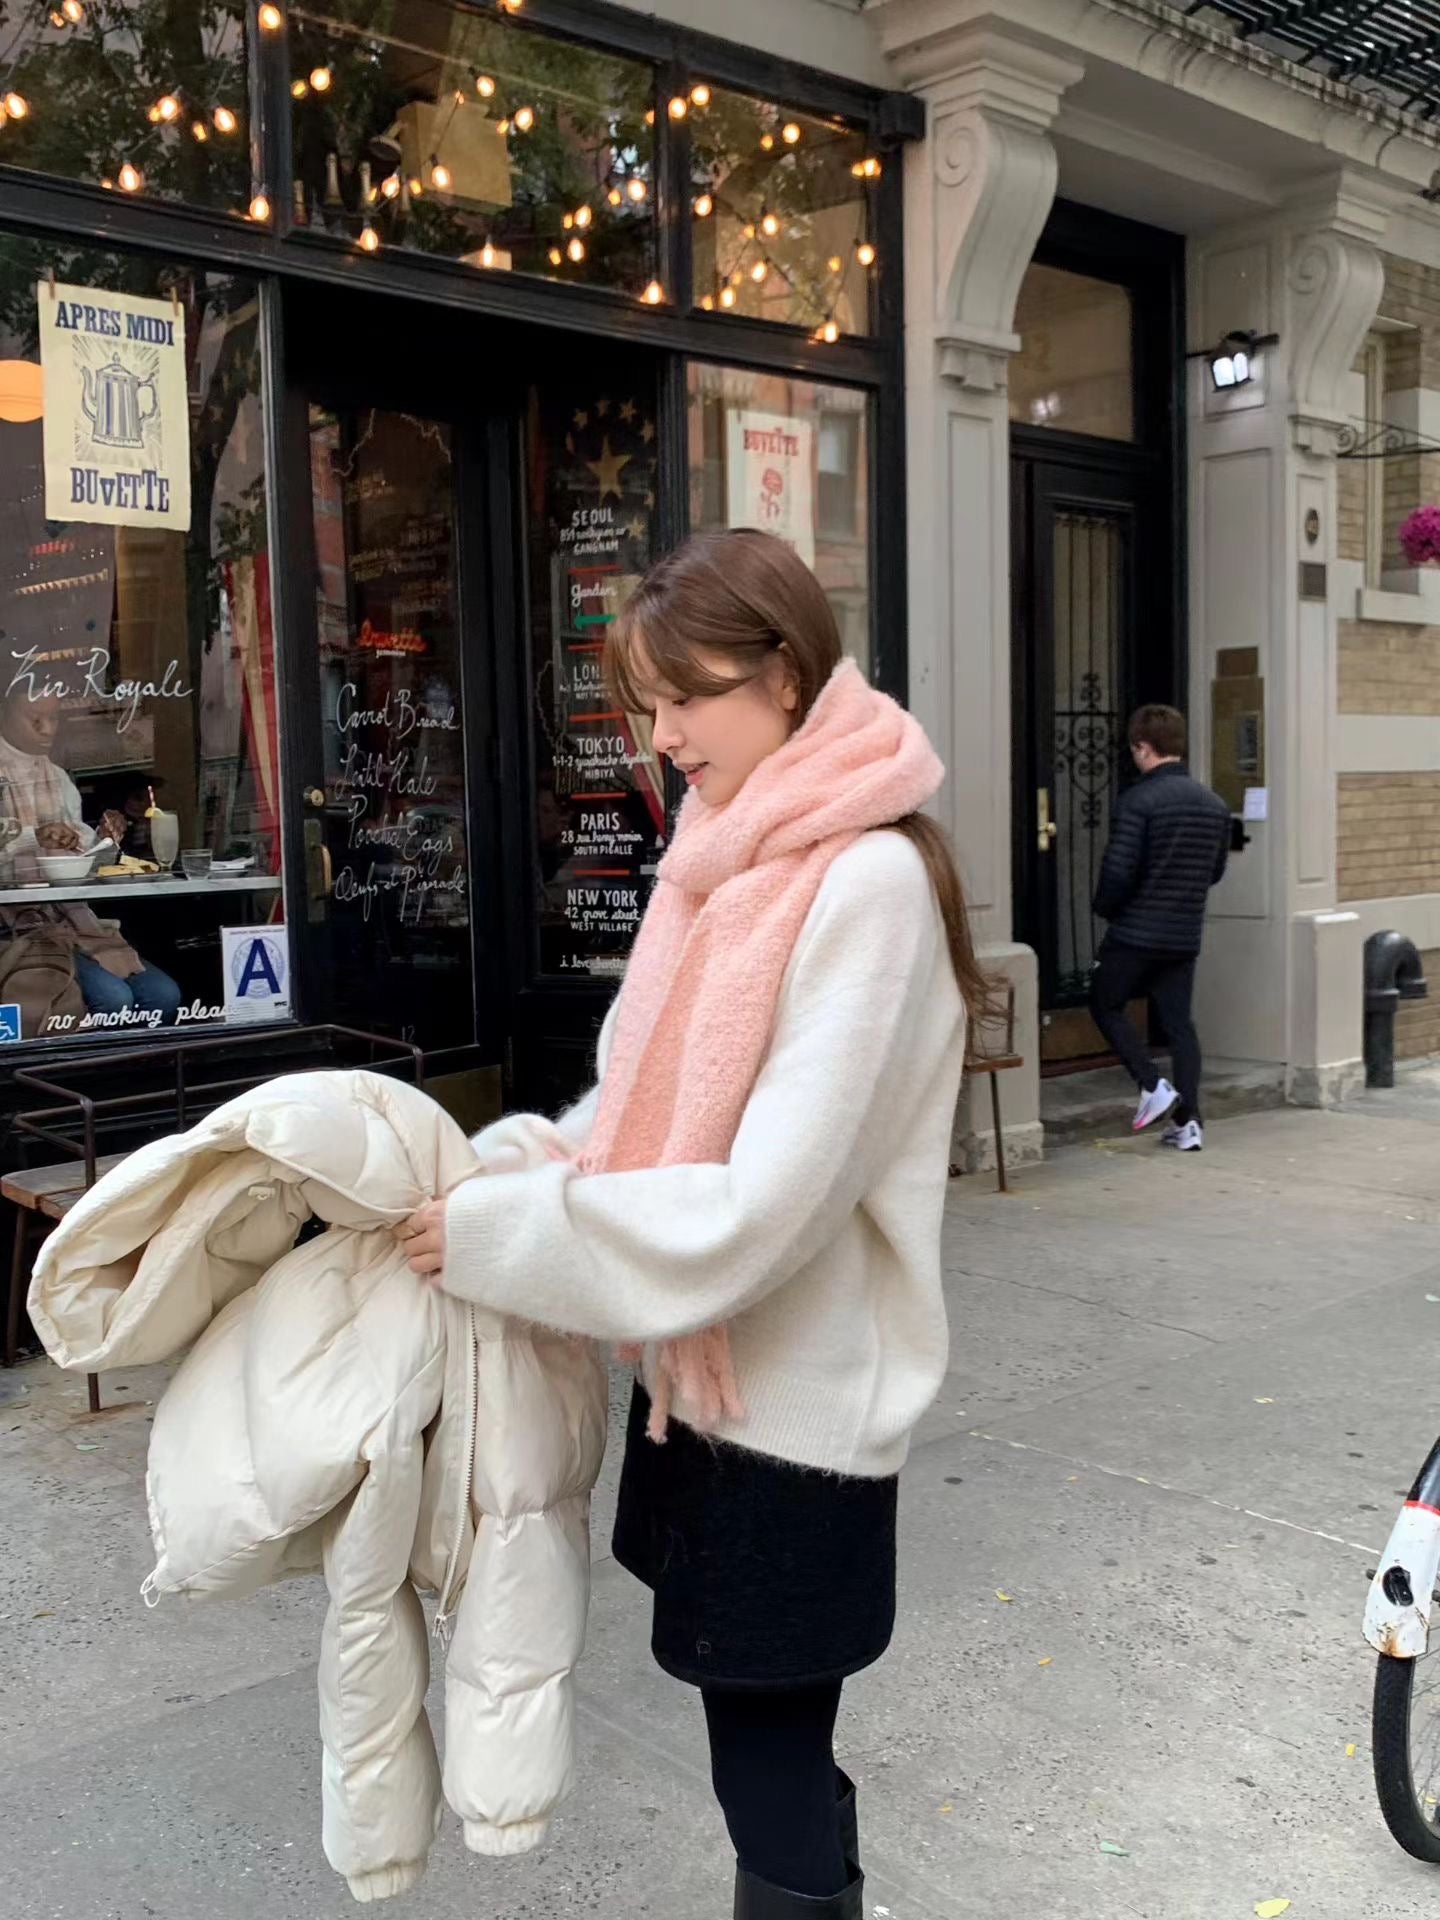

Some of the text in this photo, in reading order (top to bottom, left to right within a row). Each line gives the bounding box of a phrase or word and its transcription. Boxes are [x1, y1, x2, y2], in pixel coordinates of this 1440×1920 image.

[55, 301, 175, 346] APRES MIDI
[572, 507, 615, 527] SEOUL
[5, 645, 195, 734] Kir Royale
[336, 683, 459, 740] Carrot Bread
[576, 736, 625, 755] TOKYO
[388, 751, 438, 796] Kale
[580, 812, 621, 831] PARIS
[402, 815, 454, 876] Eggs
[561, 831, 574, 844] 28
[573, 845, 599, 856] SOUTH
[567, 888, 639, 908] NEW YORK
[564, 907, 642, 924] 42 grove street
[570, 921, 634, 933] WEST VILLAGE
[236, 938, 282, 997] A
[47, 1014, 74, 1031] no
[78, 1003, 163, 1029] smoking
